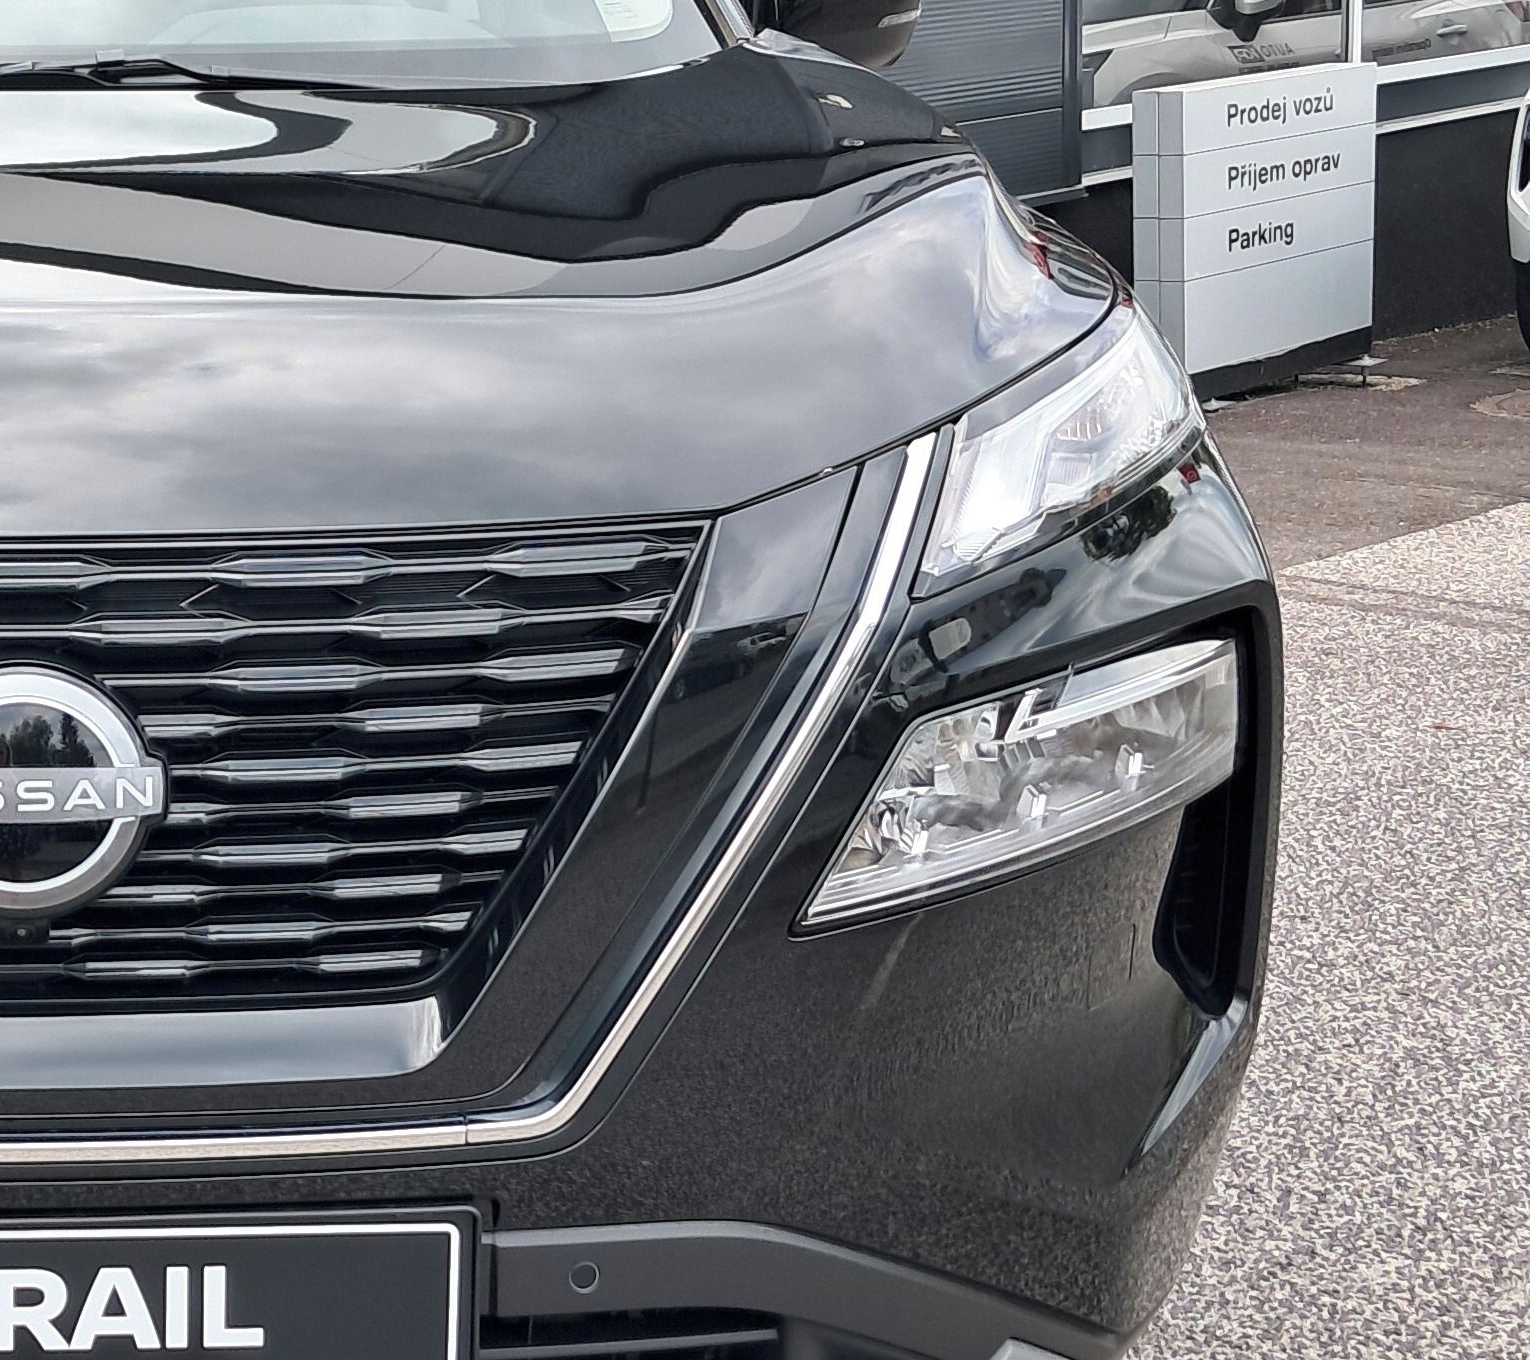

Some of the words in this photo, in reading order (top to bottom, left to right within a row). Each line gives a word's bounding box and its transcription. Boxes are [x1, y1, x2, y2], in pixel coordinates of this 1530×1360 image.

[1226, 96, 1287, 128] Prodej
[1293, 86, 1334, 117] vozů
[1227, 162, 1286, 192] Příjem
[1291, 152, 1341, 182] oprav
[1228, 221, 1295, 253] Parking
